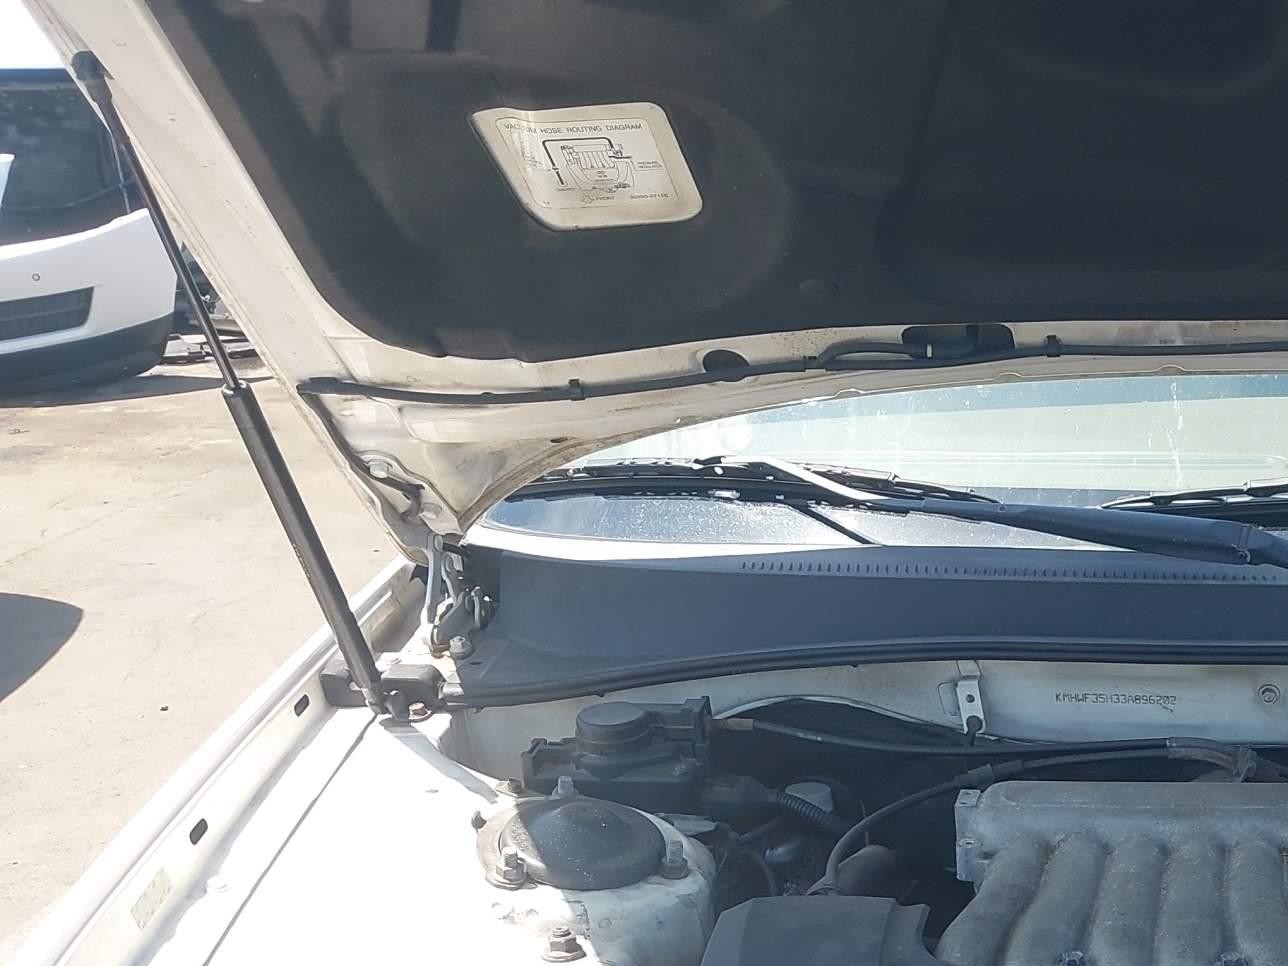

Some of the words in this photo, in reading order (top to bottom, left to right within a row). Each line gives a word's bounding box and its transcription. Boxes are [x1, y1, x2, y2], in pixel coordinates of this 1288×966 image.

[540, 126, 564, 134] HOSE
[566, 126, 602, 134] ROUTING
[606, 123, 644, 131] DIAGRAM
